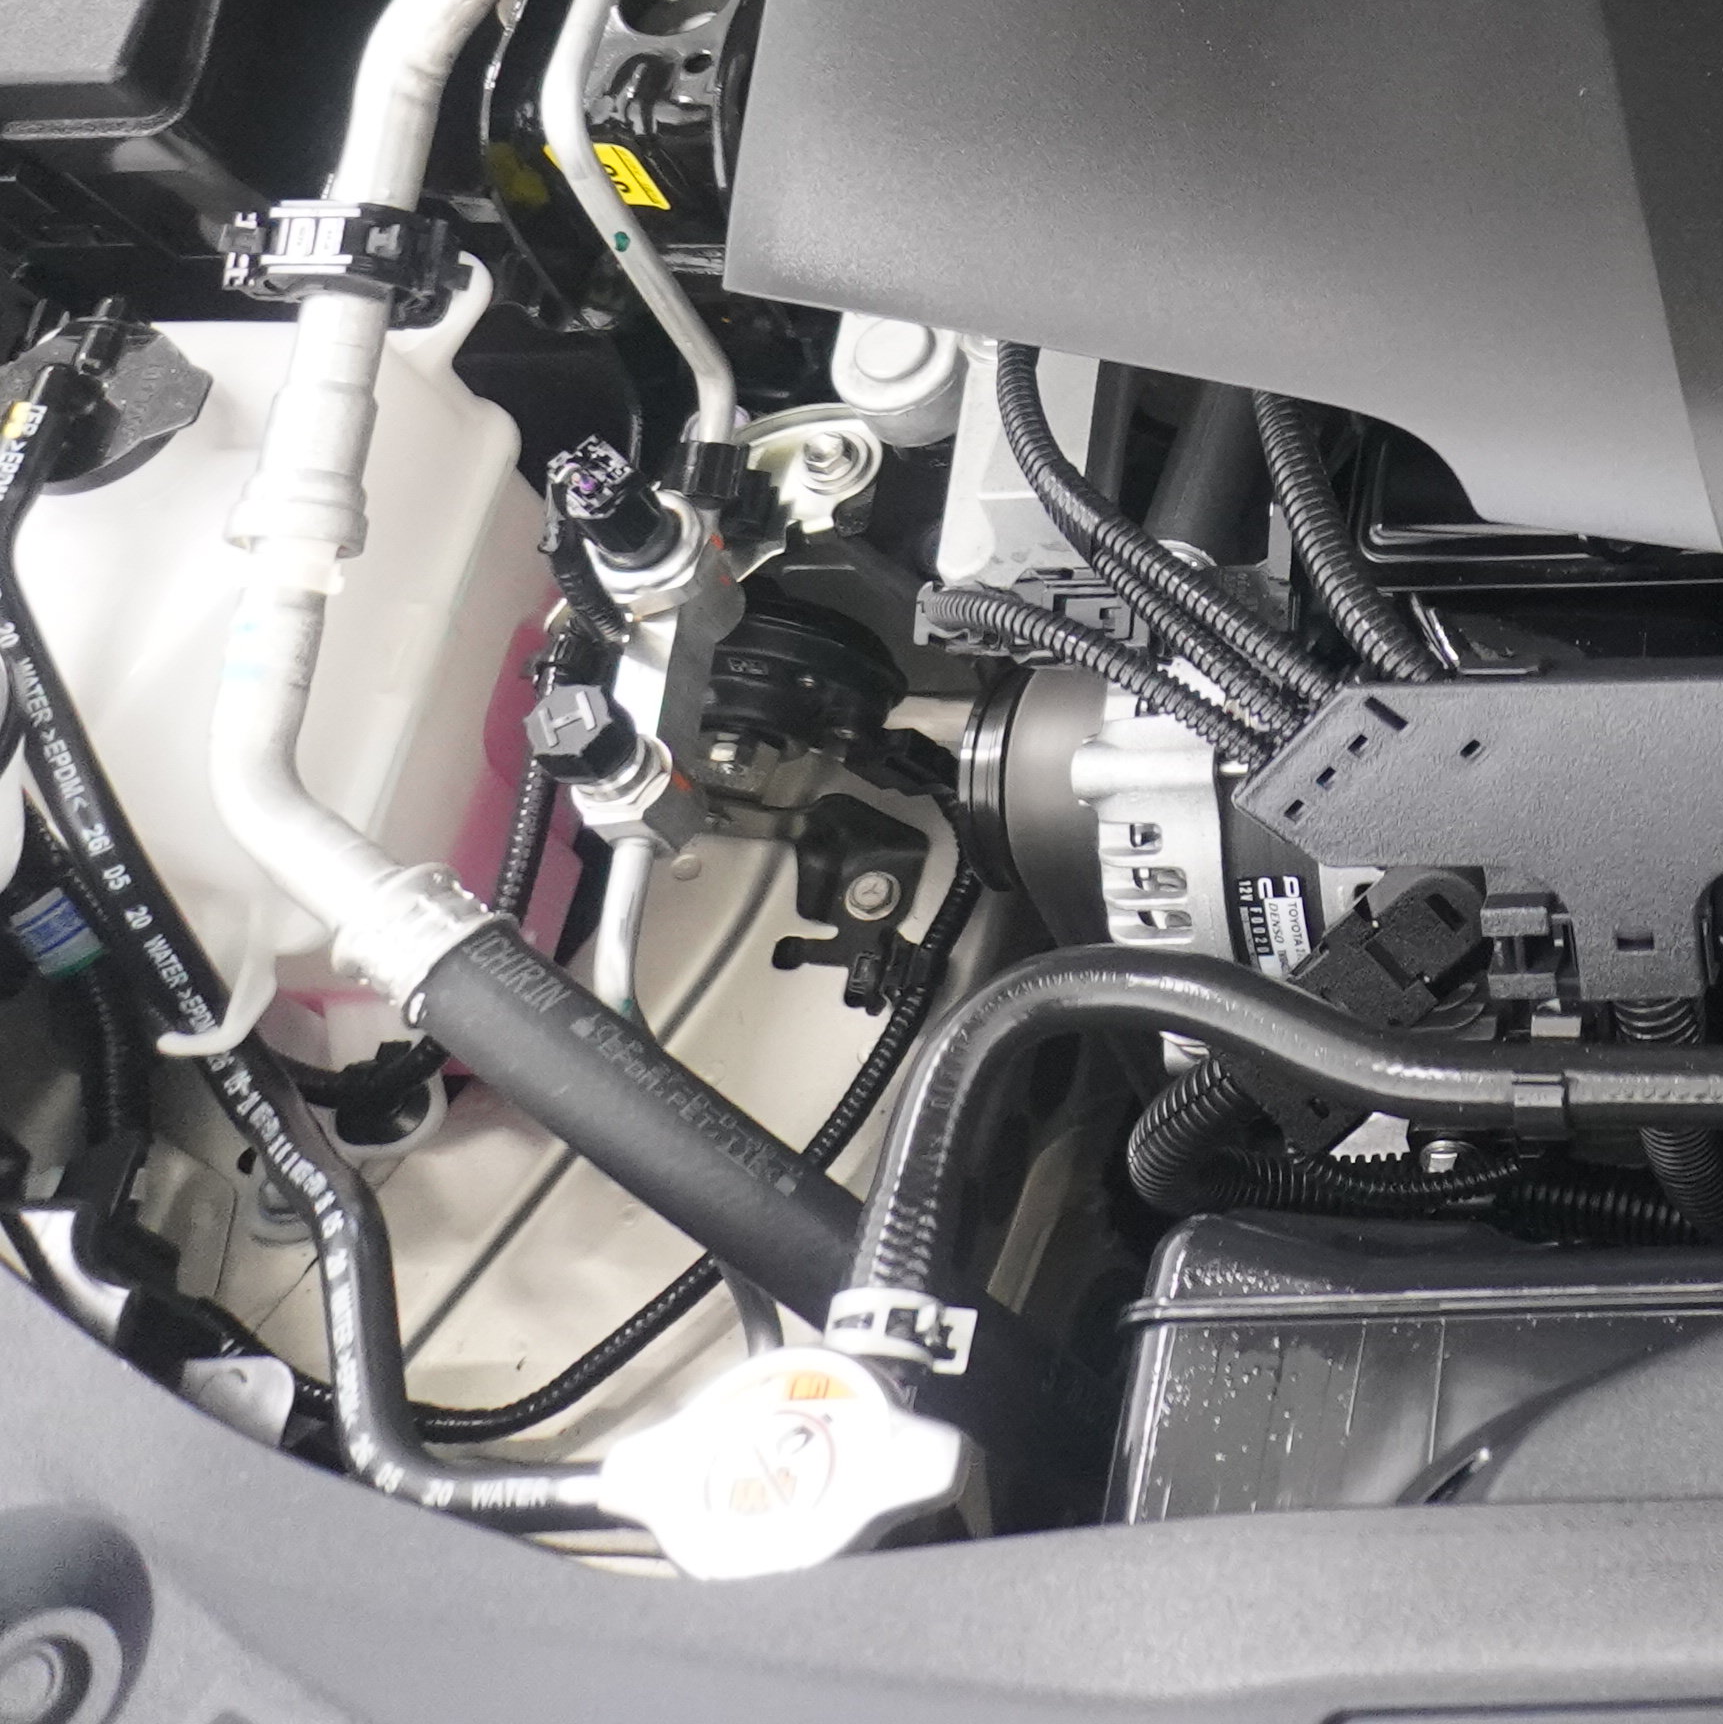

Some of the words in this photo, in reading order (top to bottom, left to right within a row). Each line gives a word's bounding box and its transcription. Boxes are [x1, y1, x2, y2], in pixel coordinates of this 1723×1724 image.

[538, 690, 597, 748] H
[14, 657, 53, 727] WATER
[102, 864, 131, 890] 05
[125, 904, 153, 930] 20
[143, 933, 190, 989] WATER
[1239, 880, 1254, 902] 12V
[1268, 903, 1284, 944] DENSO
[1288, 902, 1303, 946] TOYOTA
[466, 933, 572, 1013] ICHIRIN
[421, 1478, 455, 1508] 20
[471, 1477, 553, 1511] WATER
